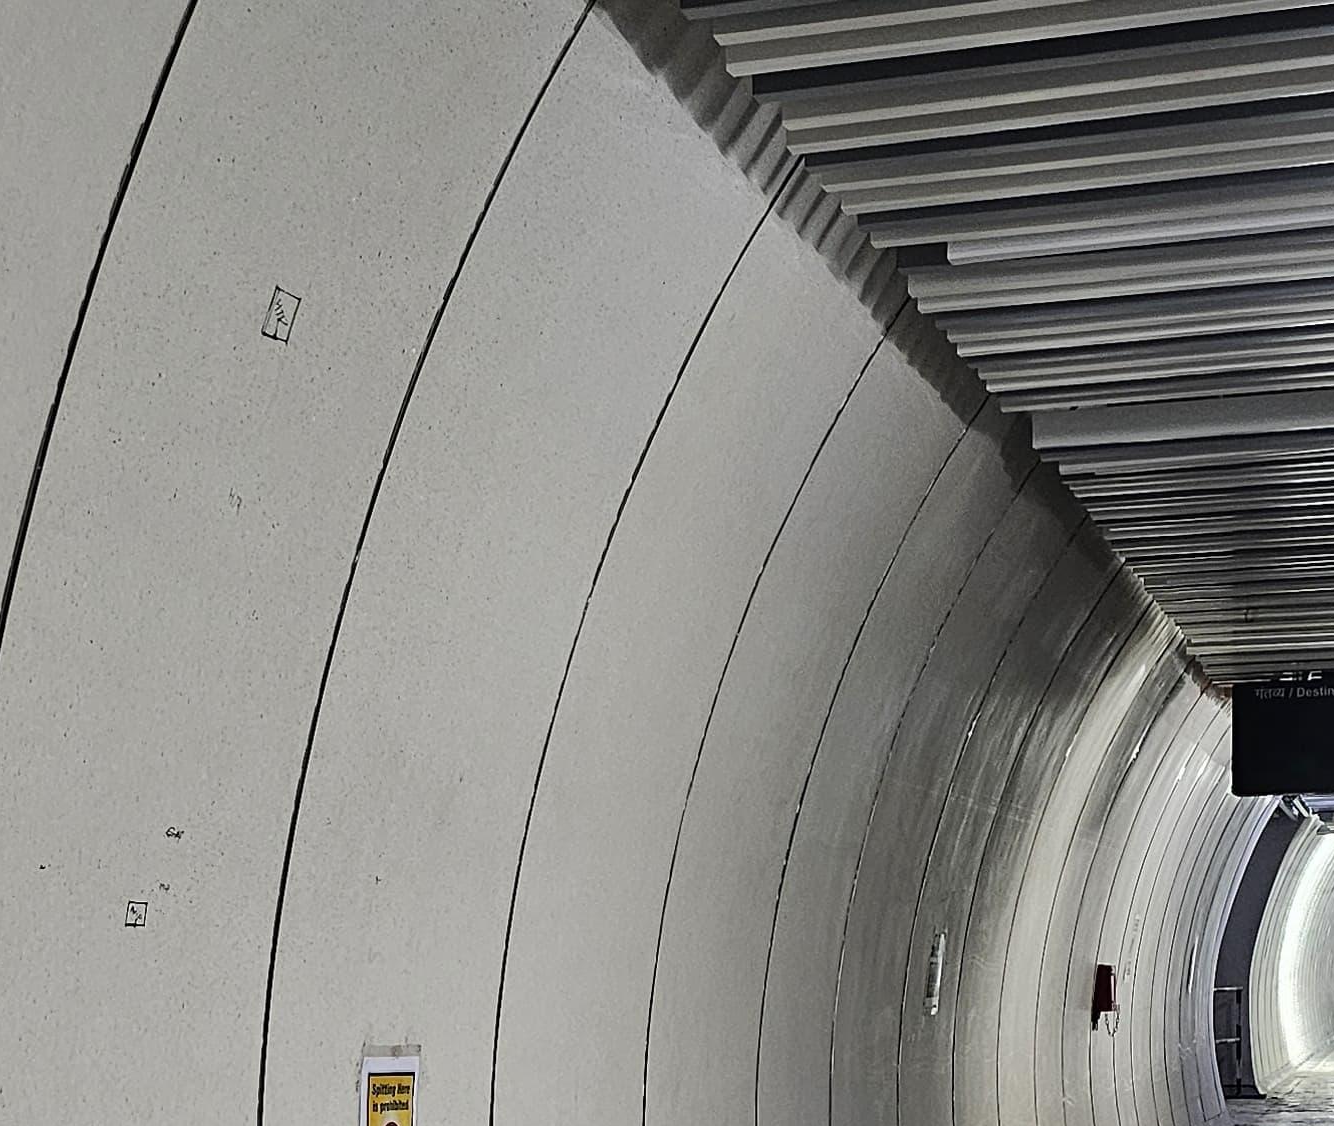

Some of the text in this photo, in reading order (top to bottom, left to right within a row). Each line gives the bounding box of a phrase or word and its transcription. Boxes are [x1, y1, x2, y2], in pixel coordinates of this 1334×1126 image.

[371, 1083, 410, 1097] Spitting Here
[372, 1099, 409, 1114] is prohibited
